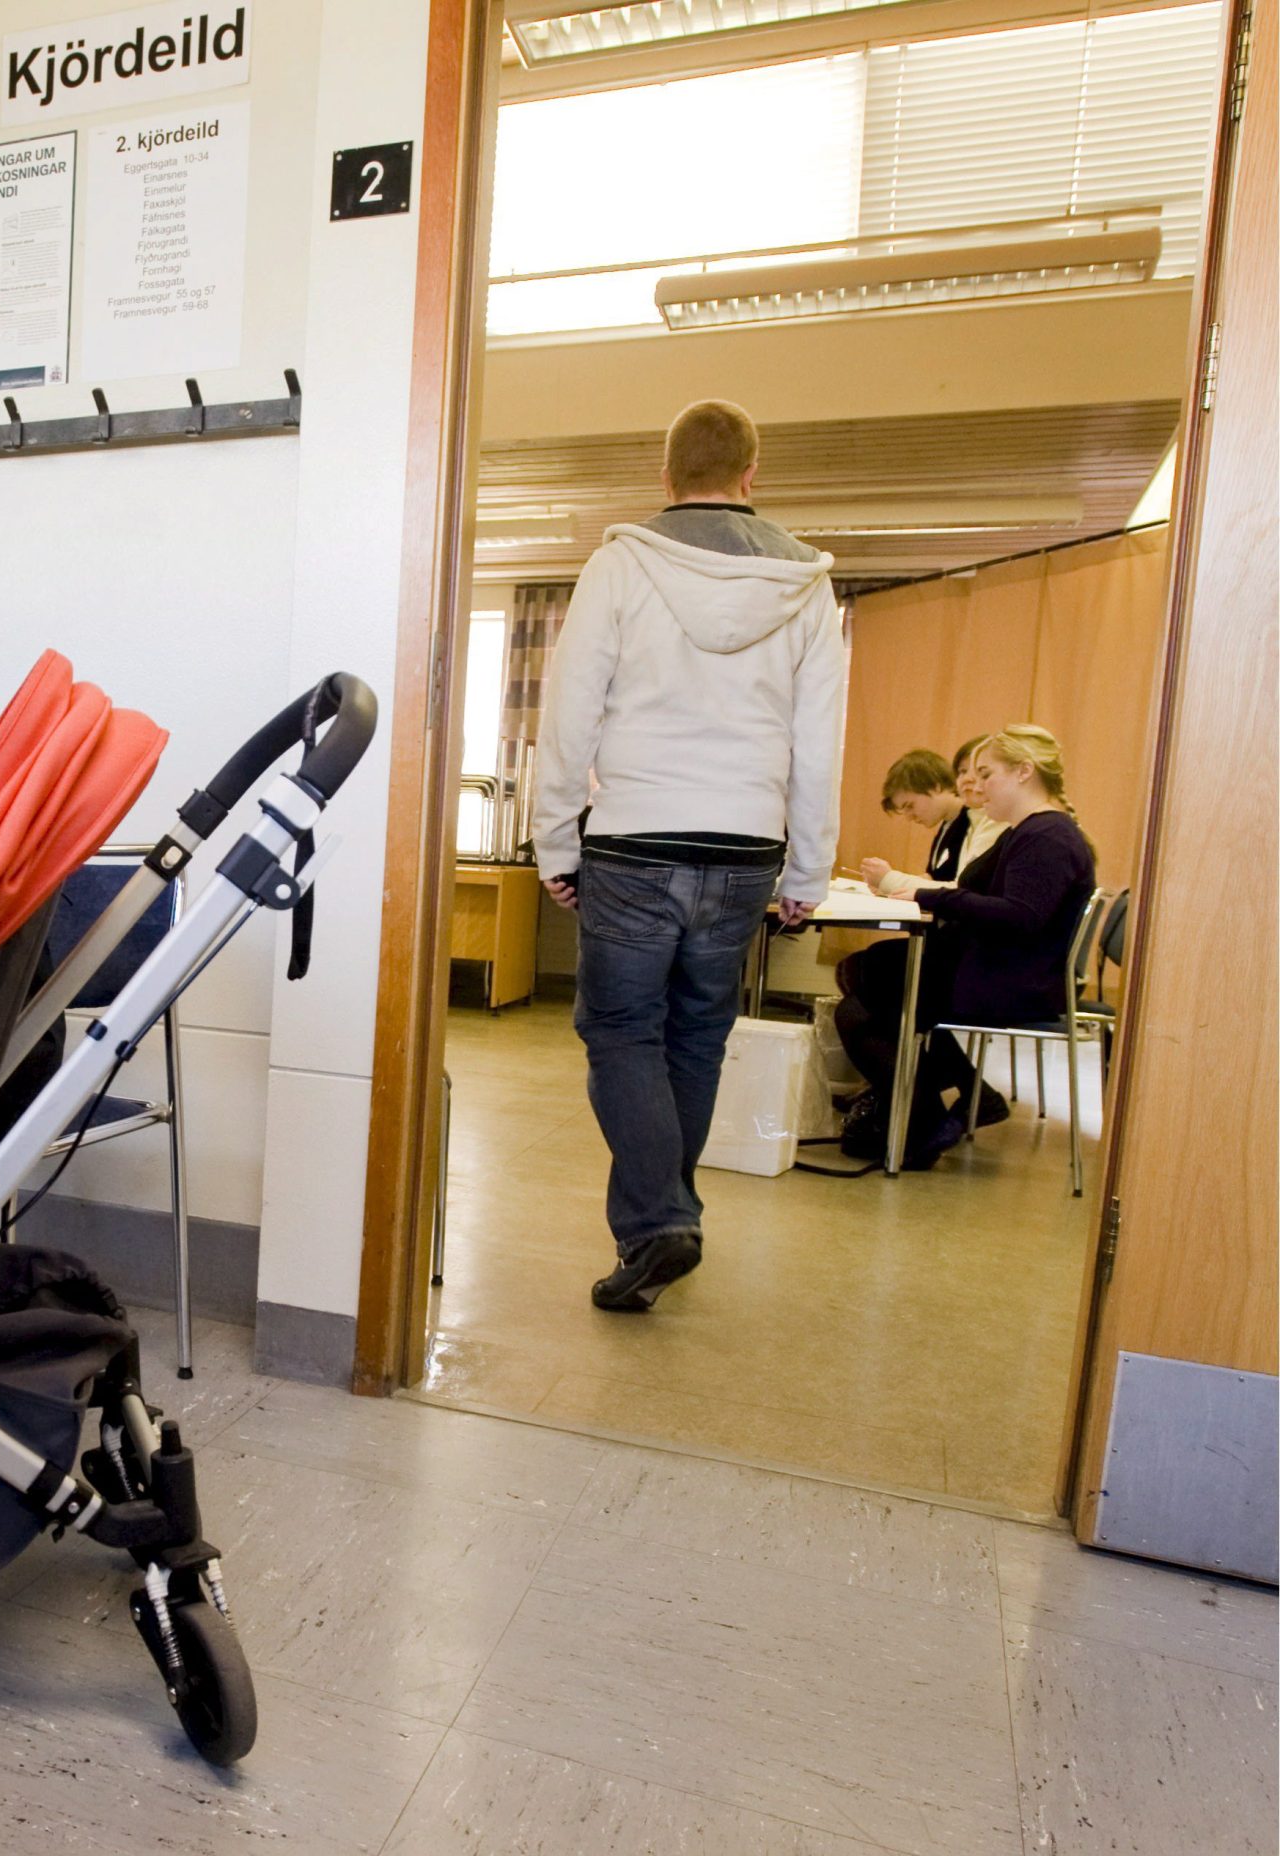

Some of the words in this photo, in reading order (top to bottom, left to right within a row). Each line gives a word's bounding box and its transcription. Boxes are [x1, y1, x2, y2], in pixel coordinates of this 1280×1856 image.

[8, 7, 245, 106] Kjördeild
[116, 135, 131, 153] 2.
[137, 119, 219, 152] kjördeild
[35, 146, 56, 161] UM
[123, 157, 178, 175] Eggertsgata
[143, 169, 188, 184] Einarsnes
[359, 160, 385, 203] 2
[142, 263, 182, 277] Fornhagi
[138, 277, 185, 290] Fossagata
[189, 288, 202, 299] og
